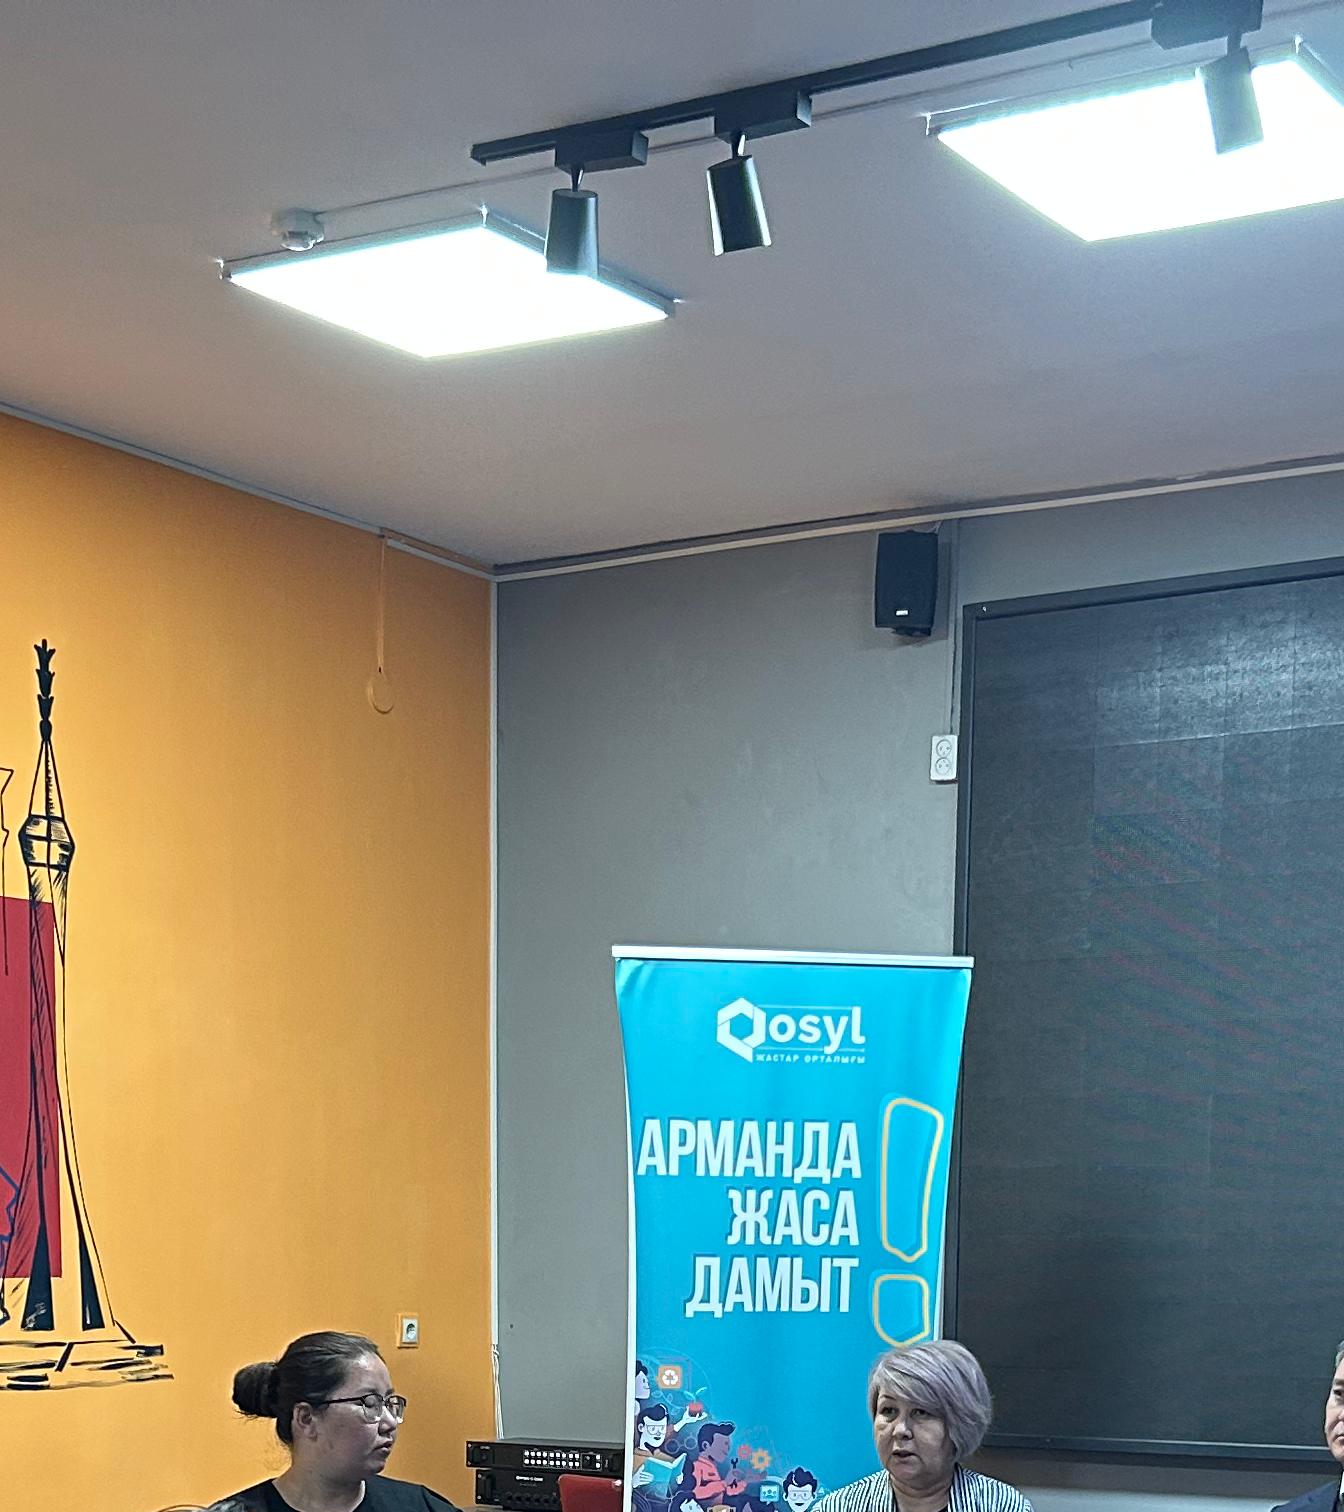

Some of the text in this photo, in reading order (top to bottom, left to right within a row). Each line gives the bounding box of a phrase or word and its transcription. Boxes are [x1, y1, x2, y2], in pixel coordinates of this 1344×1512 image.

[637, 1118, 862, 1184] АРМАНДА
[726, 1189, 860, 1247] ЖАСА
[684, 1256, 861, 1318] ДАМЫТ
